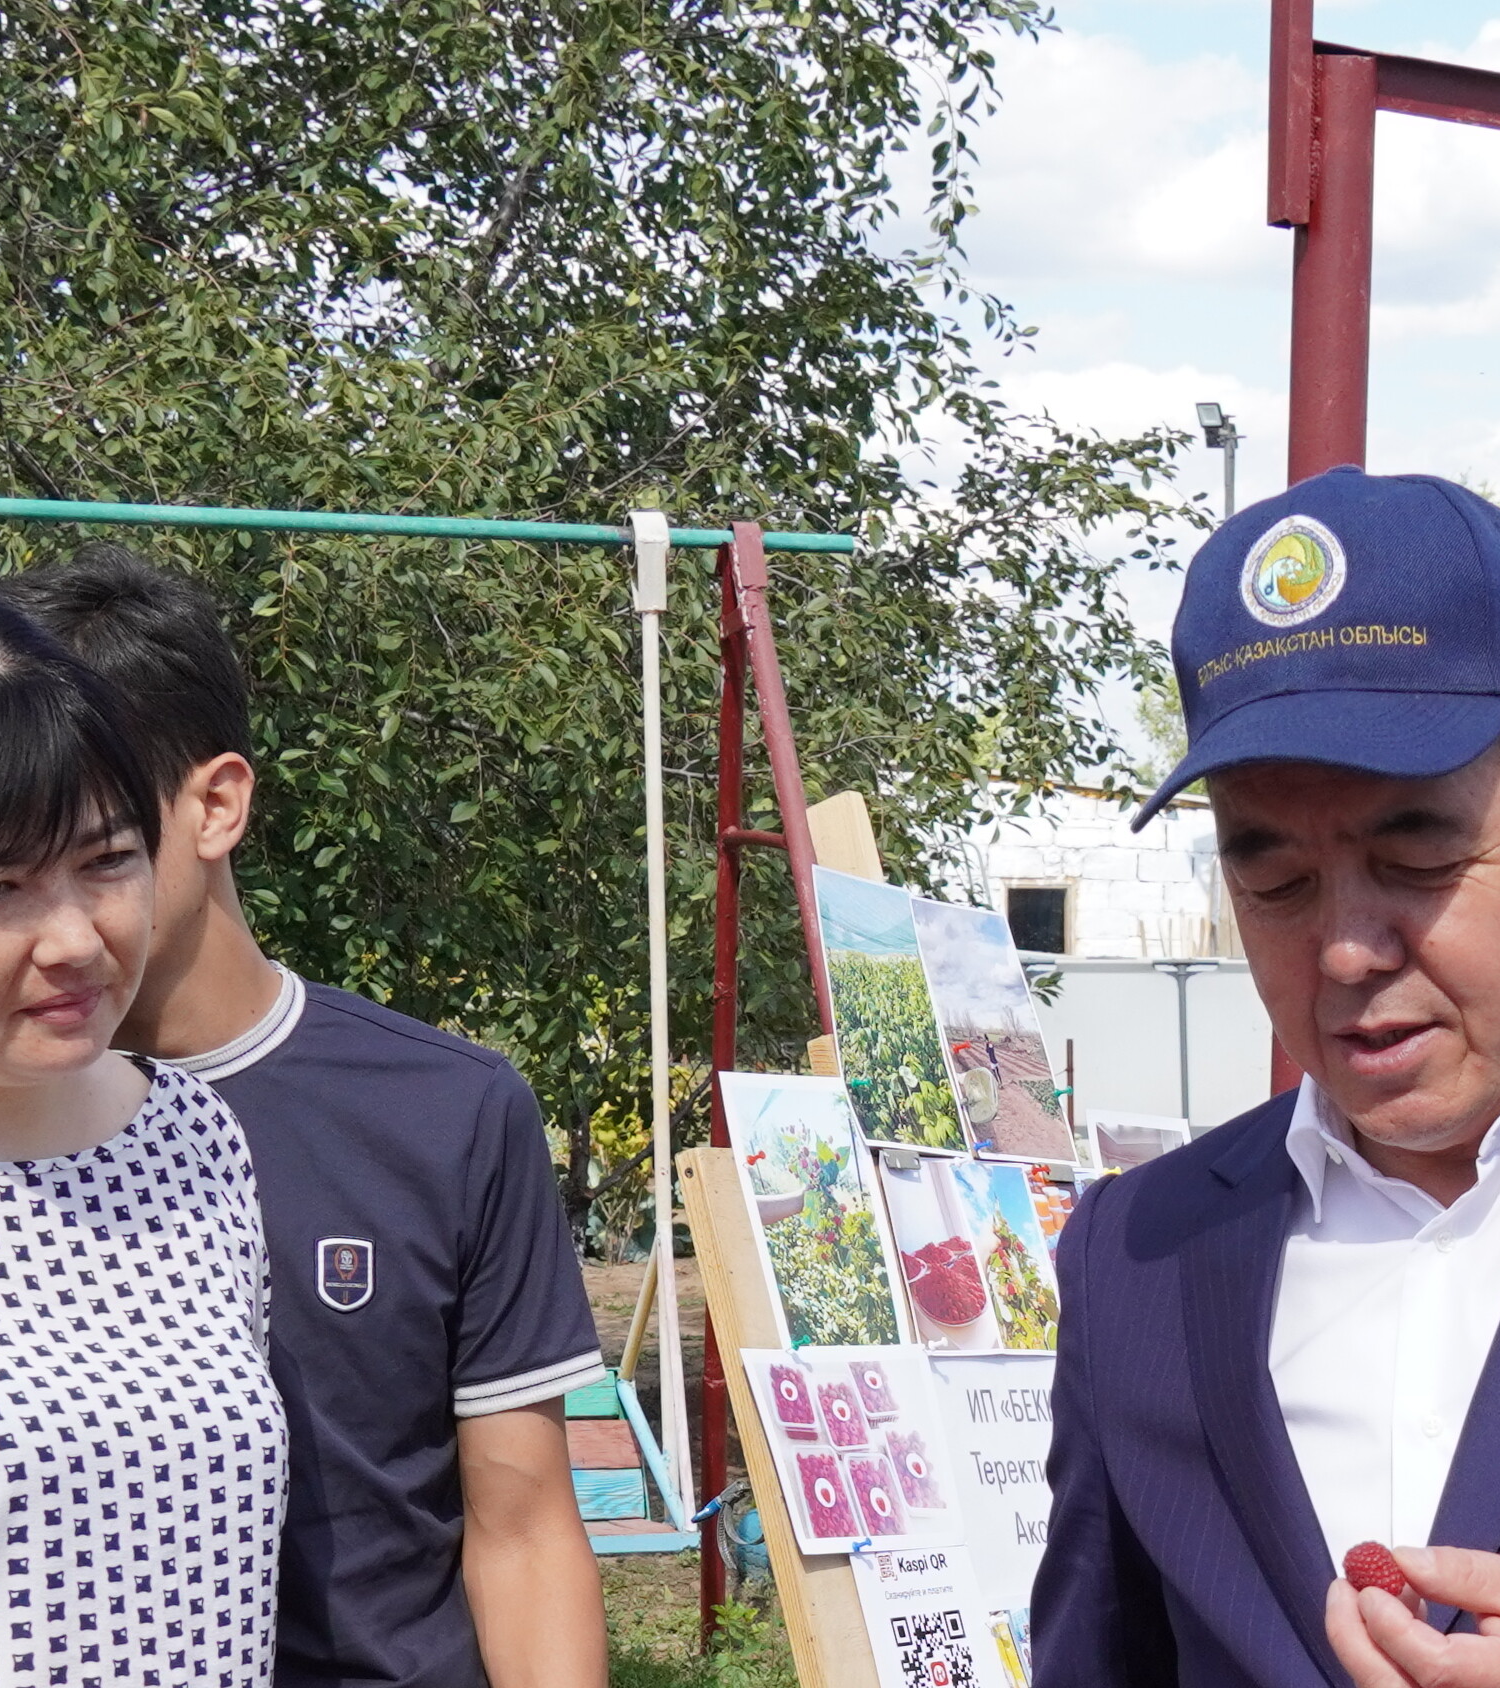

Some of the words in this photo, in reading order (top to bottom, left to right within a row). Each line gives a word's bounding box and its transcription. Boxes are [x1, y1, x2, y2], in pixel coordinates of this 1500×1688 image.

[1339, 625, 1427, 646] ОБЛЫСЫ
[966, 1388, 998, 1423] ИП
[897, 1554, 929, 1575] Kaspi
[929, 1553, 948, 1571] QR
